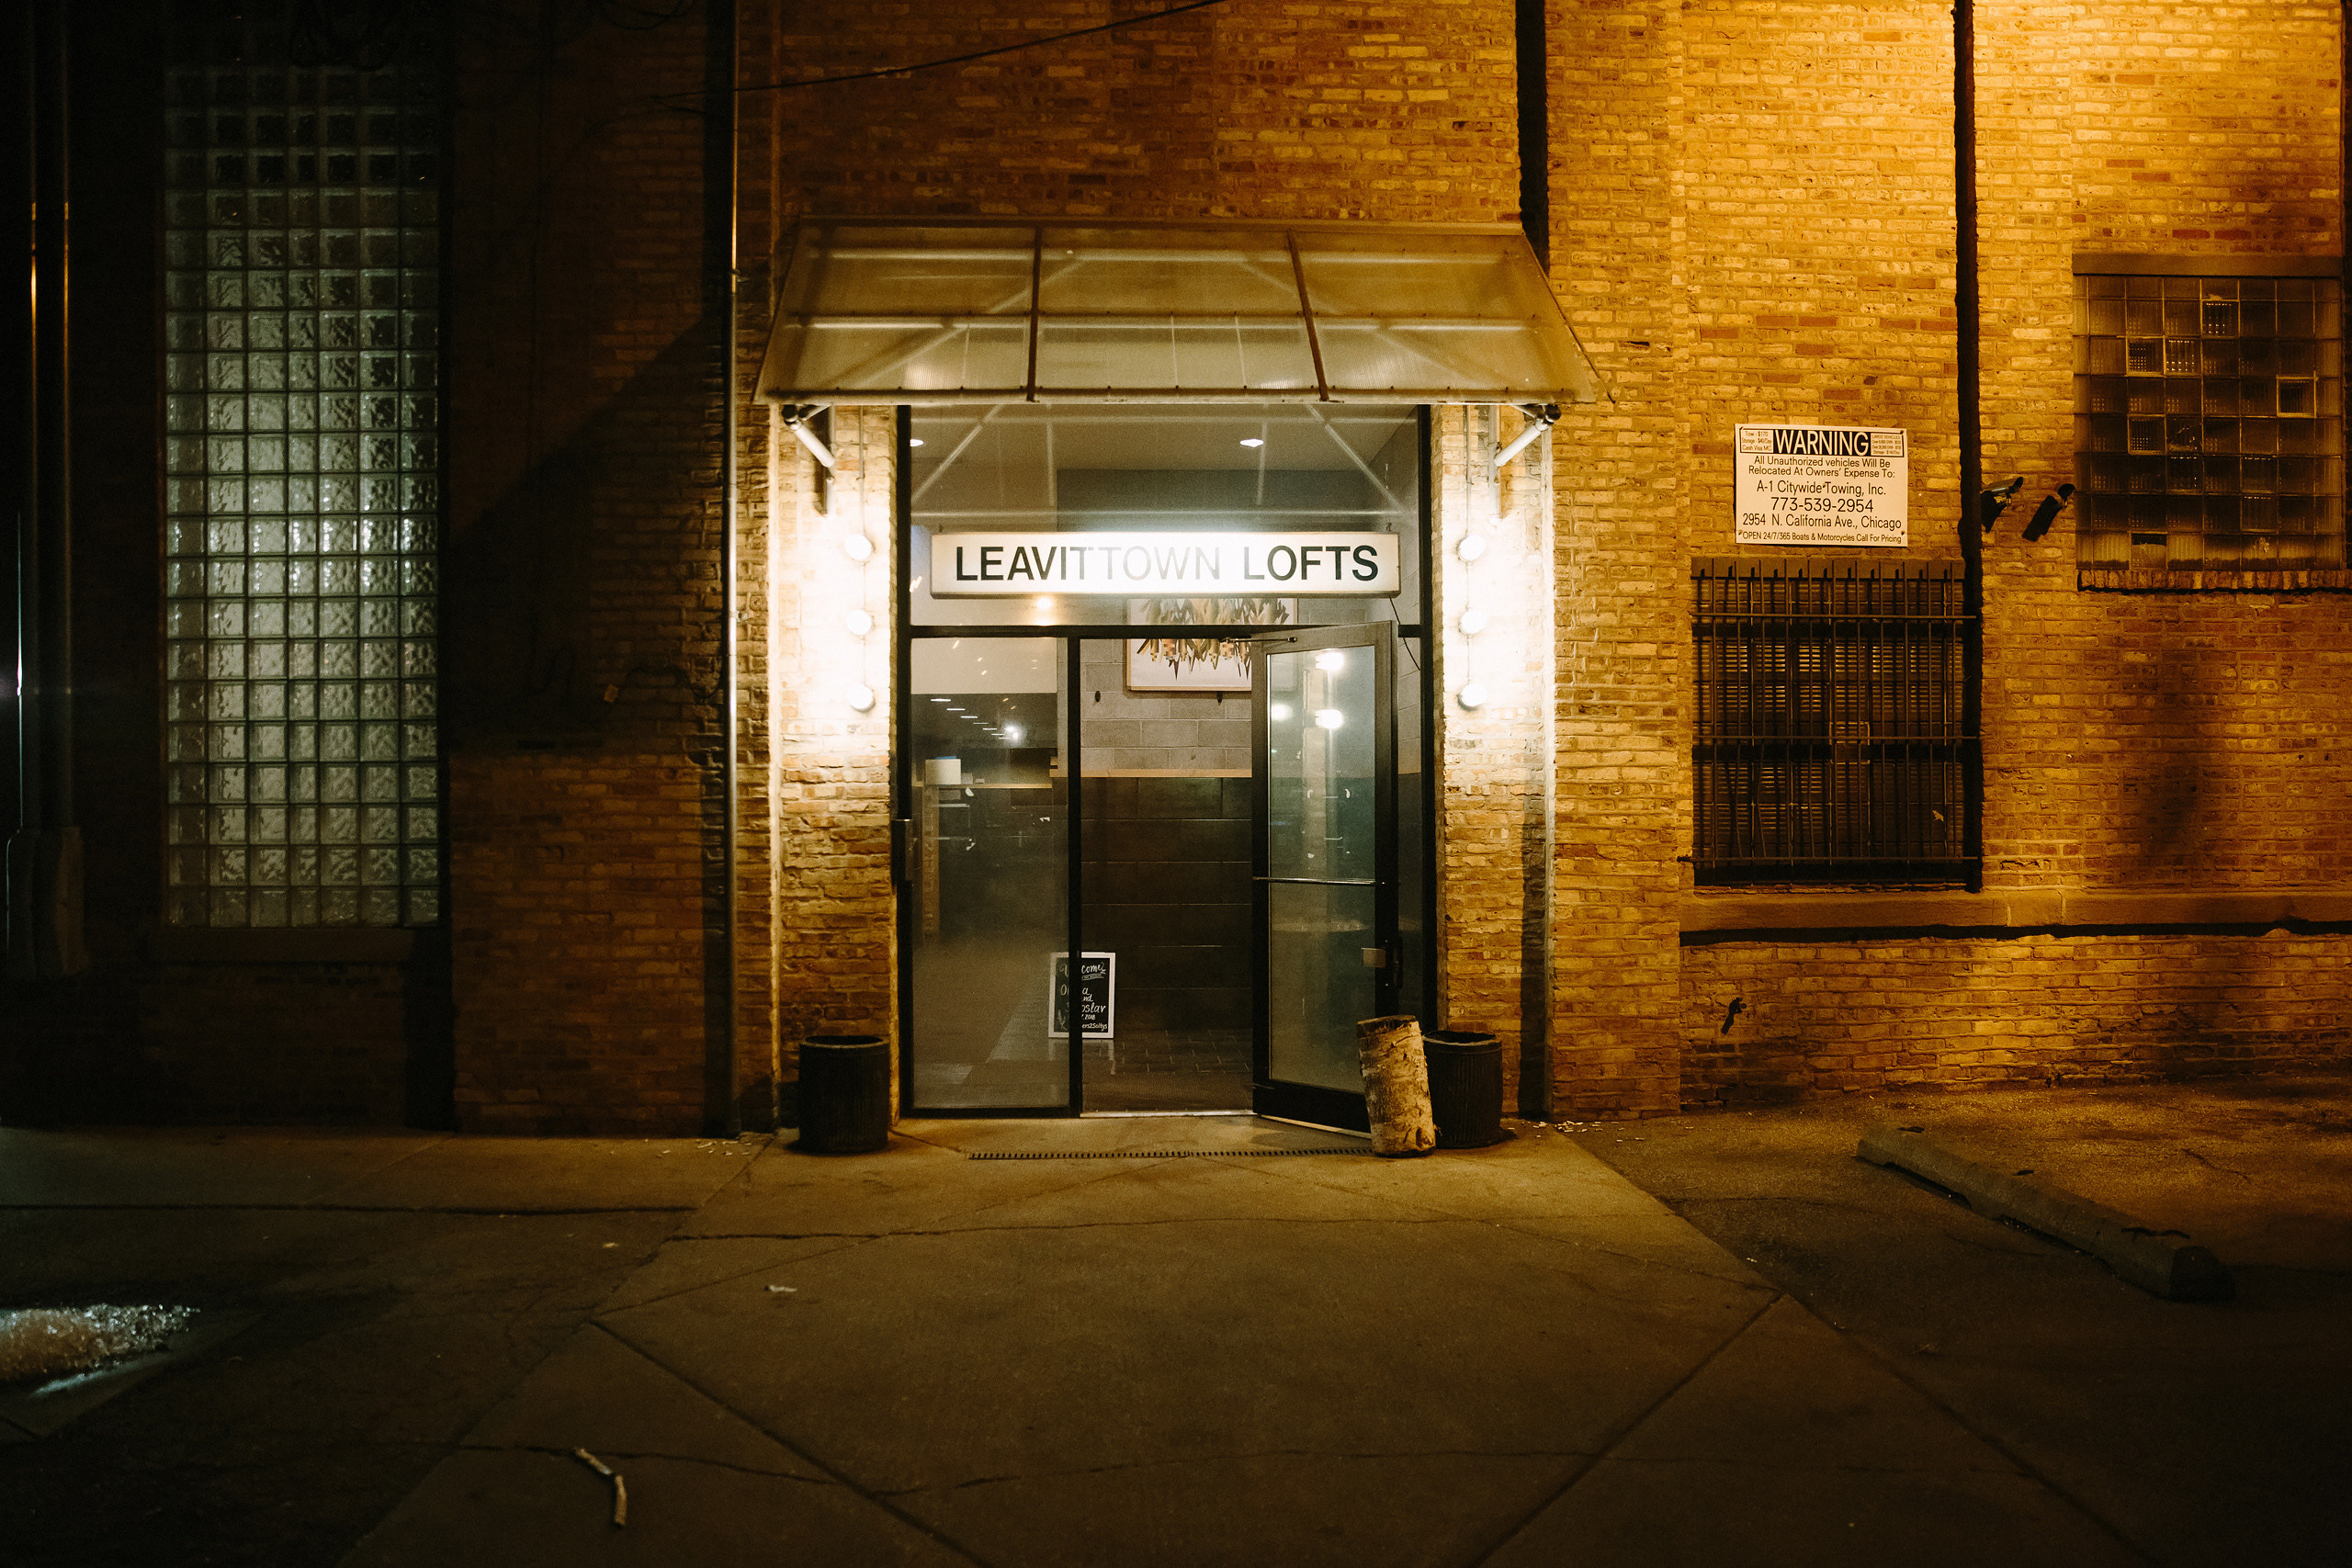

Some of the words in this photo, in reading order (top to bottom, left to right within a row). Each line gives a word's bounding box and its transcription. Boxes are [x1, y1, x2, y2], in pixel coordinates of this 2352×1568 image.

[1775, 429, 1869, 457] WARNING
[1754, 456, 1764, 465] All
[1767, 456, 1824, 467] Unauthorized
[1826, 457, 1860, 468] vehicles
[1861, 458, 1877, 468] Will
[1879, 458, 1891, 468] Be
[1748, 465, 1792, 476] Relocated
[1793, 467, 1804, 476] At
[1844, 468, 1880, 479] Expense
[1882, 468, 1895, 479] To:
[1756, 479, 1773, 492] A-1
[1777, 479, 1823, 496] Citywide
[1825, 481, 1865, 497] Towing,
[1868, 482, 1886, 495] Inc.
[1770, 496, 1874, 513] 773-539-2954
[1742, 513, 1766, 526] 2954
[1771, 513, 1782, 526] N.
[1785, 513, 1832, 527] California
[1834, 515, 1858, 529] Ave.,
[1860, 515, 1902, 531] Chicago
[1742, 531, 1762, 540] OPEN
[1763, 531, 1791, 540] 24/7/365
[1792, 532, 1810, 541] Boats
[1811, 533, 1816, 541] &
[1817, 532, 1855, 543] Motorcycles
[1856, 533, 1869, 542] Call
[1870, 534, 1880, 542] For
[1881, 534, 1902, 545] Pricing
[955, 546, 1221, 581] LEAVITTOWN
[1243, 545, 1379, 581] LOFTS
